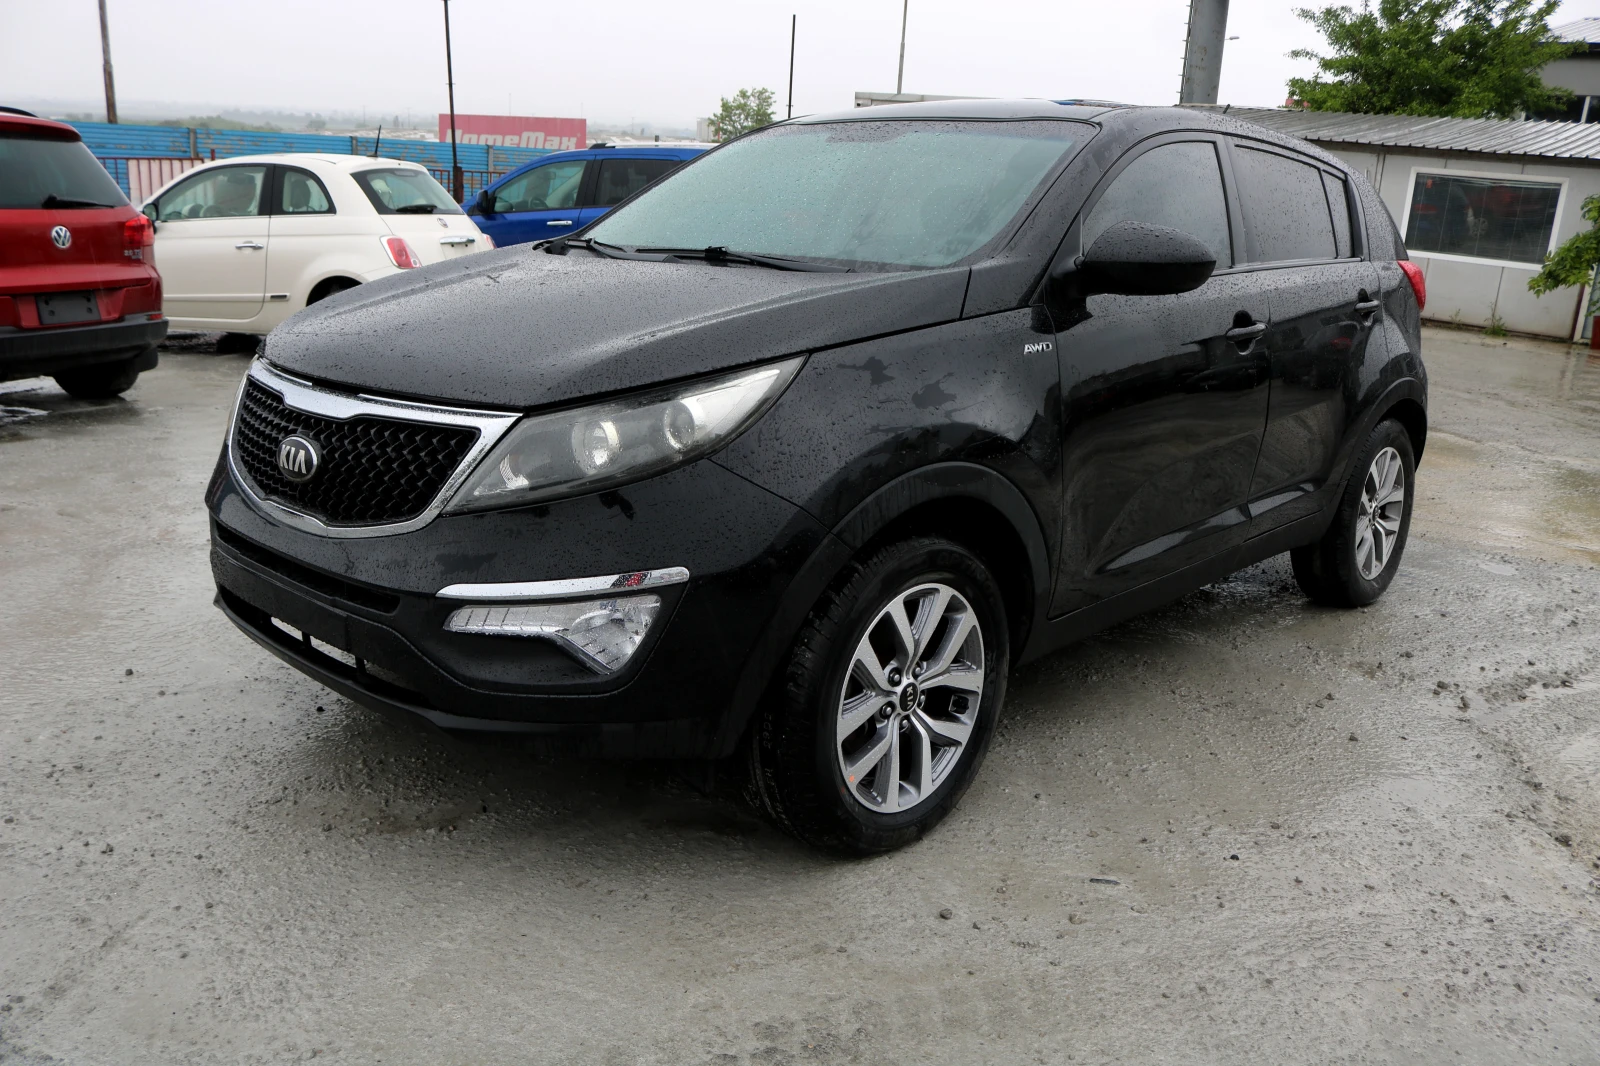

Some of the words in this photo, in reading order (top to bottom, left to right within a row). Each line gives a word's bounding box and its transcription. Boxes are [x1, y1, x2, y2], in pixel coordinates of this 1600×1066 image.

[1024, 342, 1052, 355] AWD
[280, 444, 307, 474] KIA
[906, 685, 914, 710] KIA
